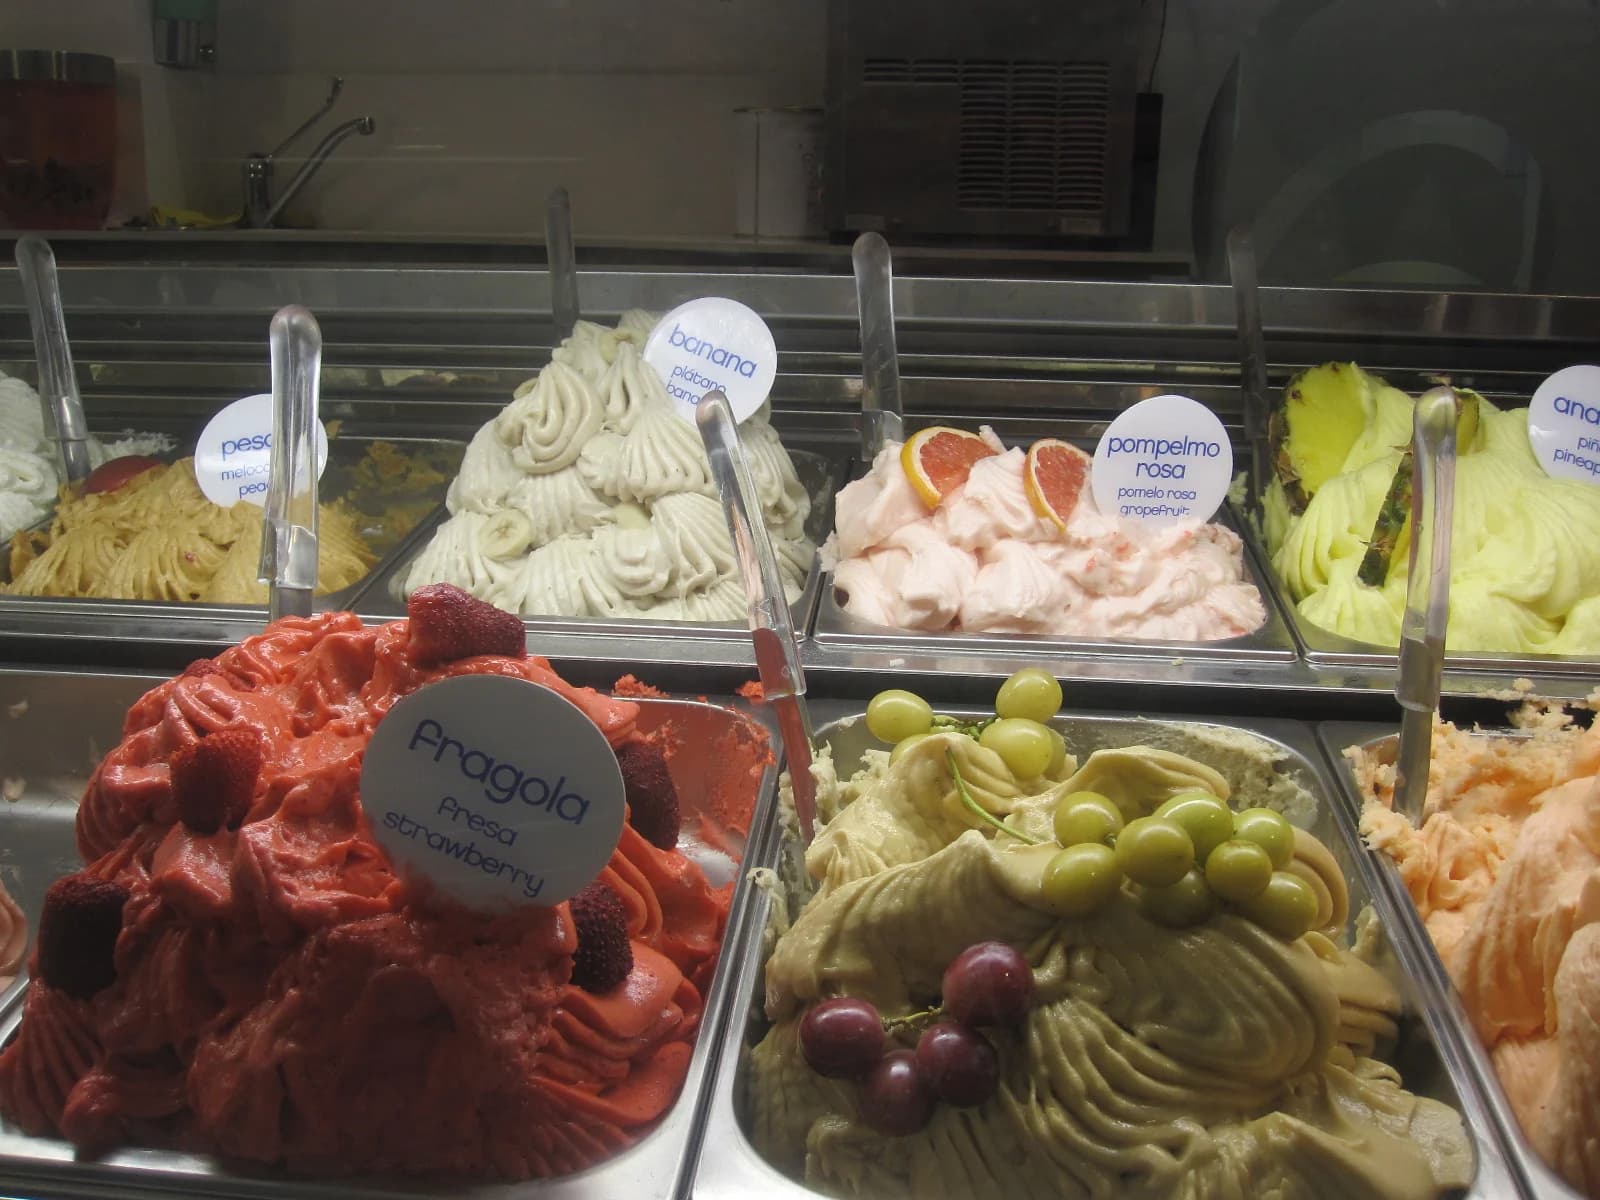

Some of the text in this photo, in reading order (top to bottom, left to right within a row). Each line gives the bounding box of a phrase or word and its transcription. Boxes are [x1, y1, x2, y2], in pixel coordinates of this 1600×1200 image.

[668, 323, 757, 378] banana
[665, 380, 700, 405] bana
[671, 365, 727, 394] plátano
[1553, 396, 1600, 425] ana
[221, 433, 272, 461] pesc
[1107, 435, 1220, 460] pompelmo
[1577, 437, 1600, 454] piñ
[221, 463, 270, 480] meloco
[1136, 462, 1186, 479] rosa
[1553, 448, 1600, 476] pineap
[239, 481, 270, 499] pea
[1117, 486, 1197, 500] pomelo rosa
[408, 719, 590, 825] fragola
[437, 796, 519, 847] fresa
[383, 810, 545, 899] strawberry
